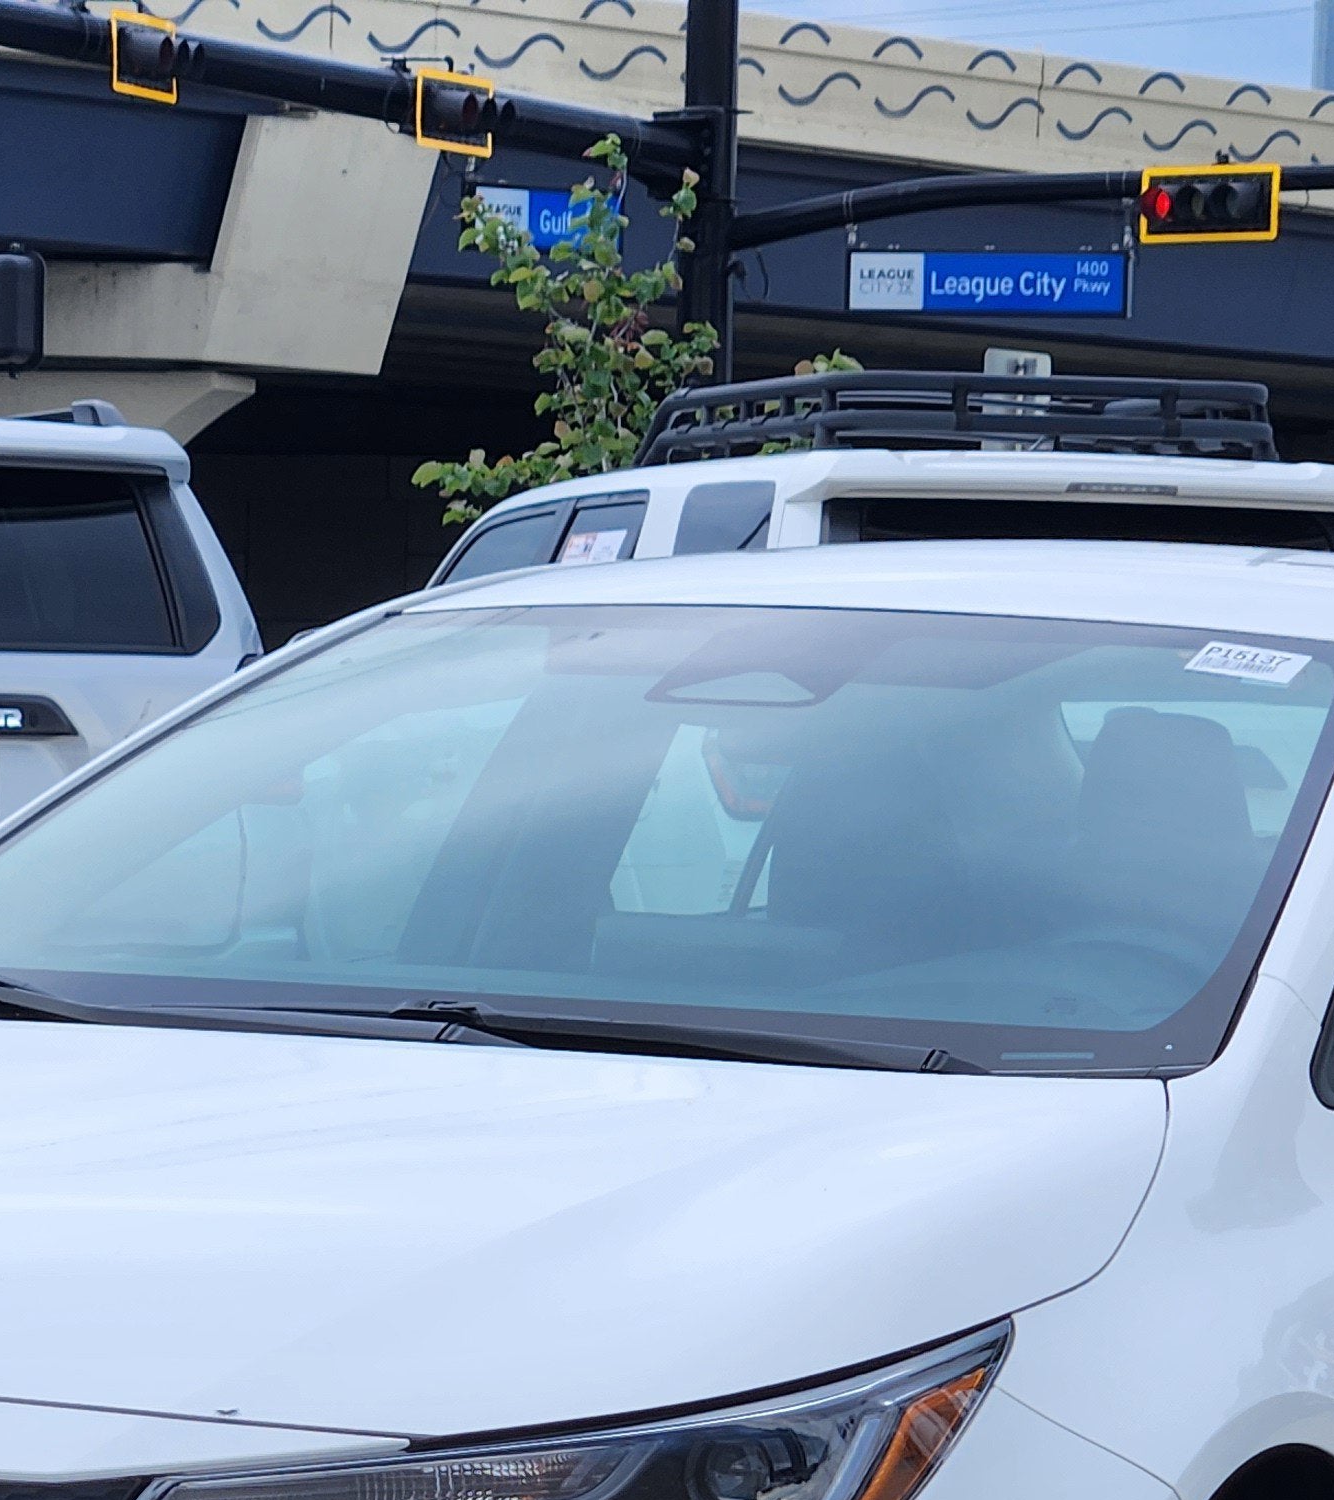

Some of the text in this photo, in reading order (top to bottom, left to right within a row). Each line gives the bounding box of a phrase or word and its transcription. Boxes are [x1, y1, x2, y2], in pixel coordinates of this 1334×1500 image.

[859, 268, 915, 280] LEAGUE
[1076, 260, 1109, 277] 1400
[930, 270, 1067, 303] League City
[1073, 279, 1111, 297] Pkwy
